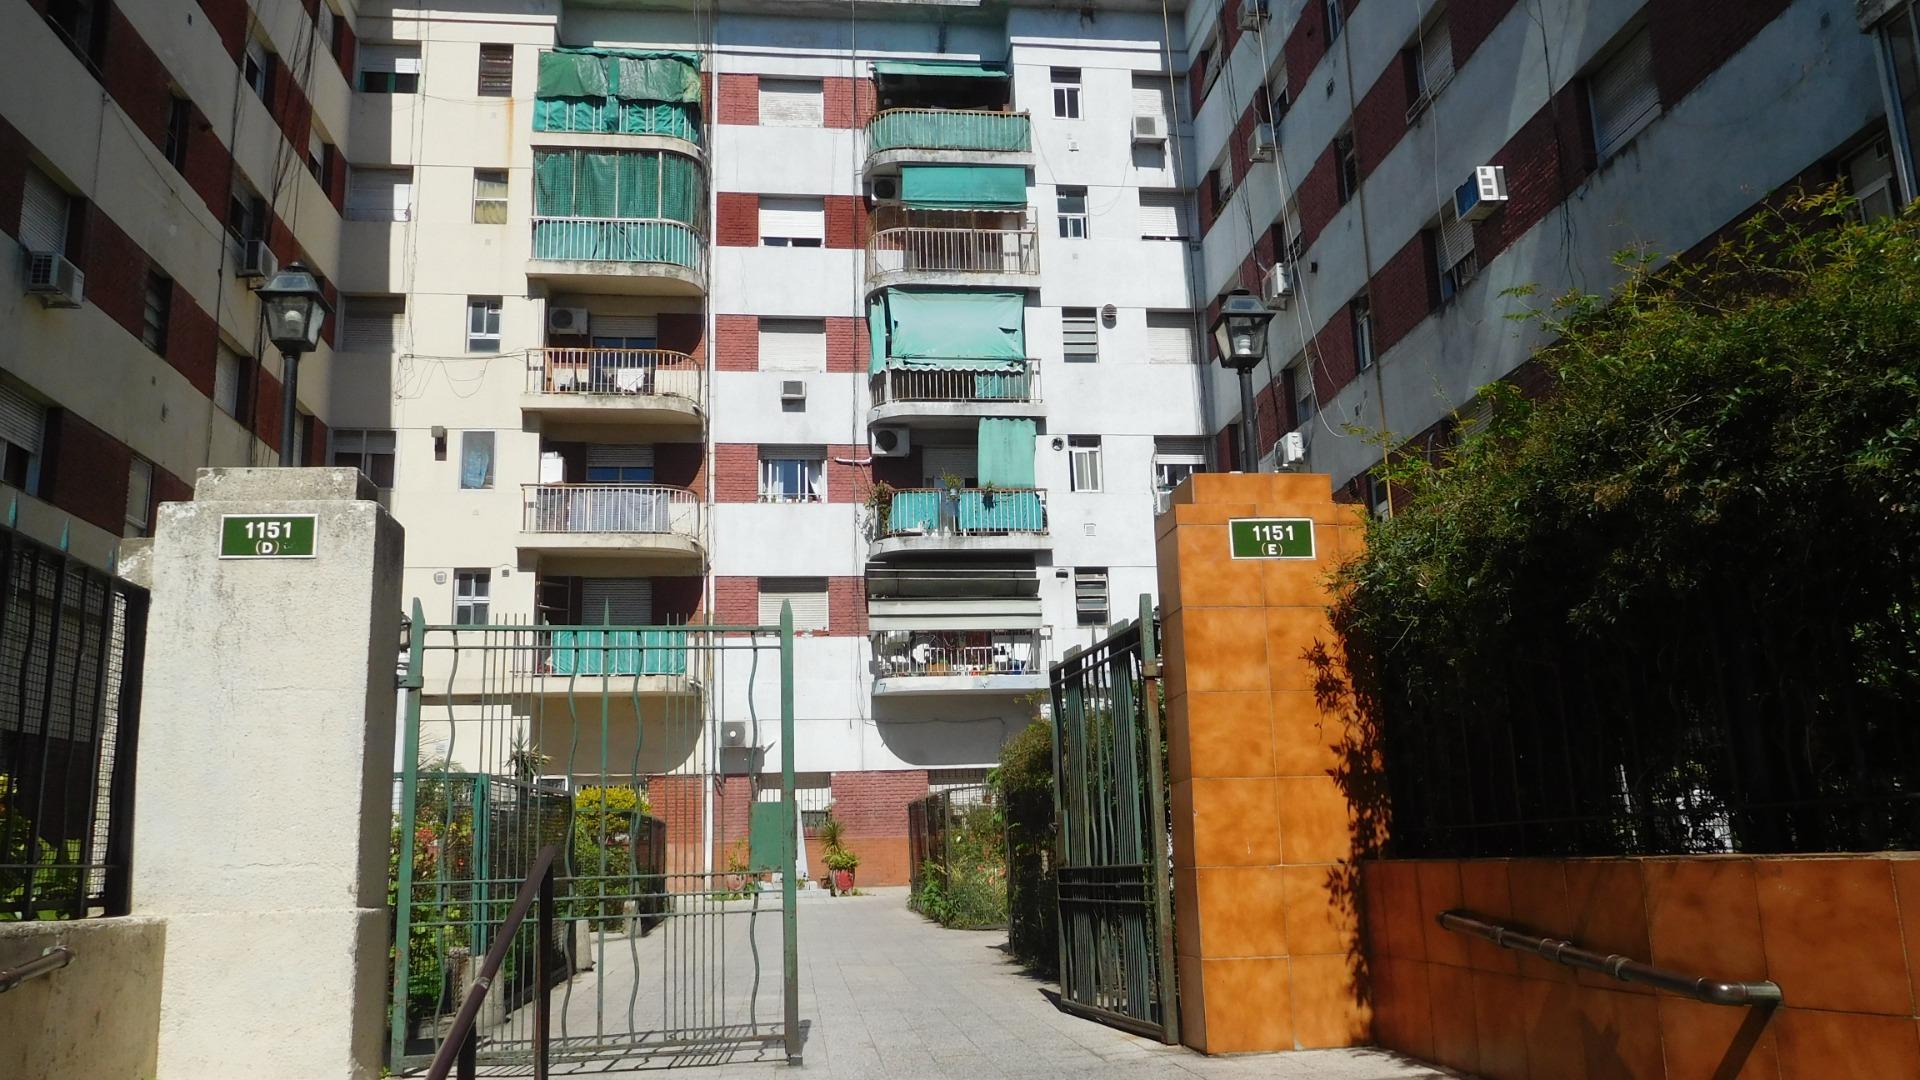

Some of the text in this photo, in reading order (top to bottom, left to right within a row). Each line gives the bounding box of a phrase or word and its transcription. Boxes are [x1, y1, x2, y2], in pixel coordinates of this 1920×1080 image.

[245, 521, 292, 539] 1151
[1252, 525, 1294, 541] 1151
[1261, 543, 1284, 556] (E)
